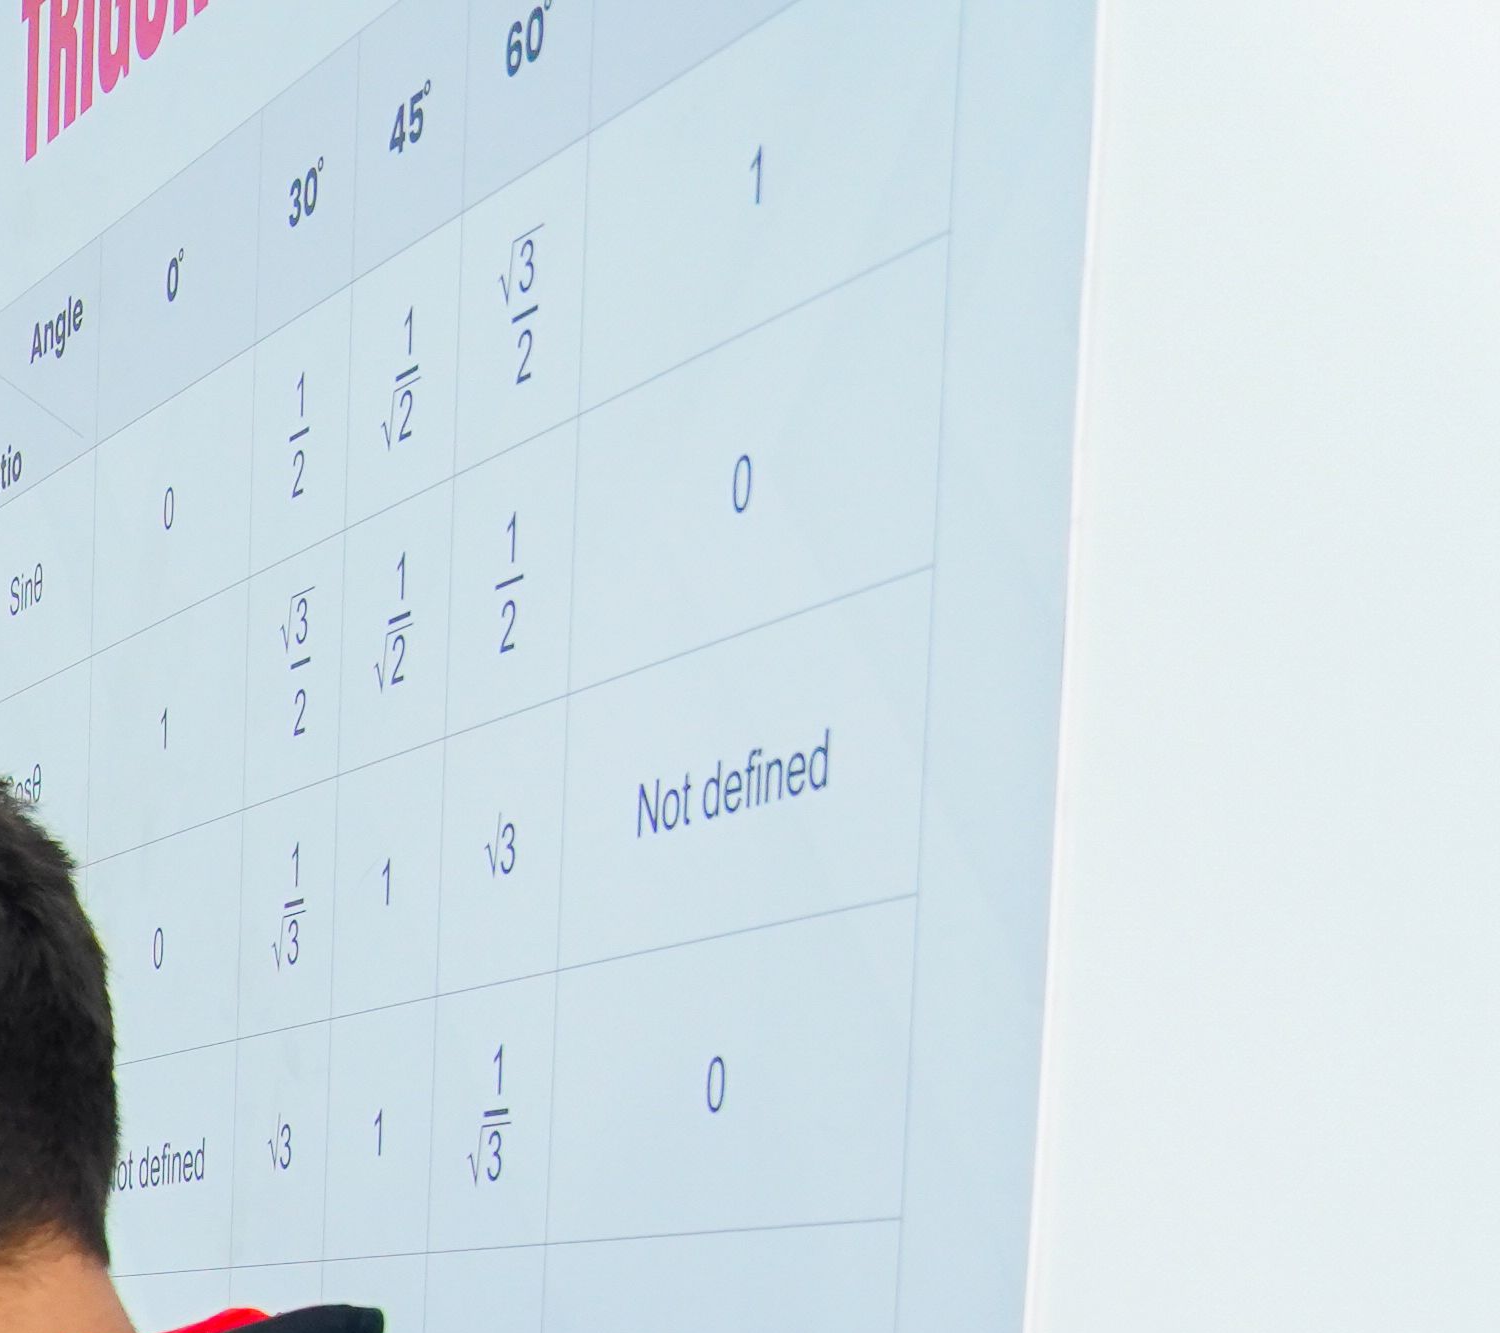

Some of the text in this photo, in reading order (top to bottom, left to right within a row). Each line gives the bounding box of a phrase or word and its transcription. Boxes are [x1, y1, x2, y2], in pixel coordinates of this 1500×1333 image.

[388, 78, 432, 155] 45°
[288, 155, 325, 229] 30°
[749, 144, 764, 205] 1
[166, 247, 185, 303] 0°
[29, 295, 84, 365] Angle
[403, 305, 414, 356] 1
[515, 327, 533, 386] 2
[296, 371, 306, 418] 1
[291, 449, 305, 500] 2
[732, 453, 753, 515] 0
[163, 485, 175, 531] 0
[506, 510, 517, 564] 1
[396, 551, 406, 601] 1
[499, 599, 517, 655] 2
[160, 706, 168, 750] 1
[293, 688, 307, 737] 2
[636, 727, 831, 839] Not defined
[291, 841, 300, 889] 1
[381, 857, 391, 907] 1
[153, 926, 164, 971] 0
[493, 1043, 504, 1096] 1
[706, 1055, 726, 1115] 0
[373, 1107, 383, 1157] 1
[138, 1136, 206, 1189] defined
